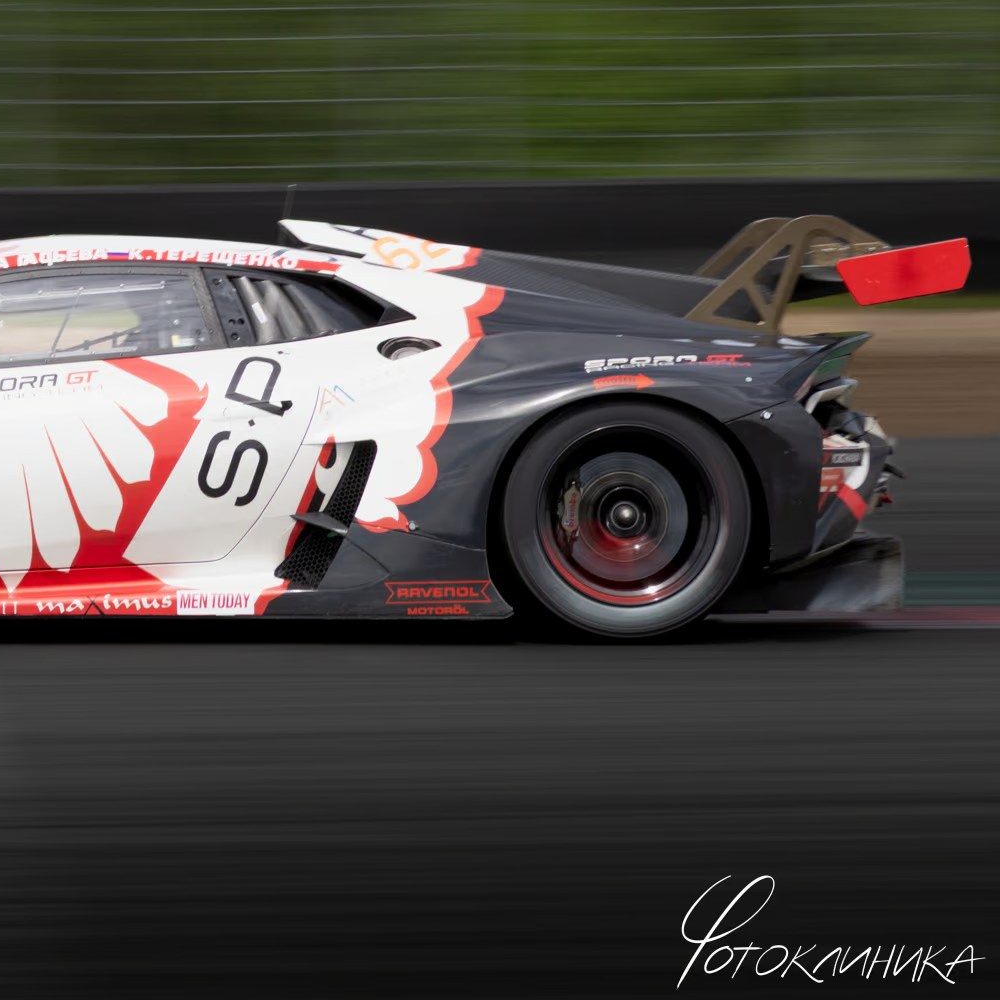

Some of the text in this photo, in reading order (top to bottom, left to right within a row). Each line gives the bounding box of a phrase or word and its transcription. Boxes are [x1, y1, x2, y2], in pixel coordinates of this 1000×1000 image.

[66, 370, 99, 385] GT
[396, 586, 480, 599] RAVENOL
[179, 591, 251, 609] MEN TODAY
[407, 603, 470, 615] MOTORÖL
